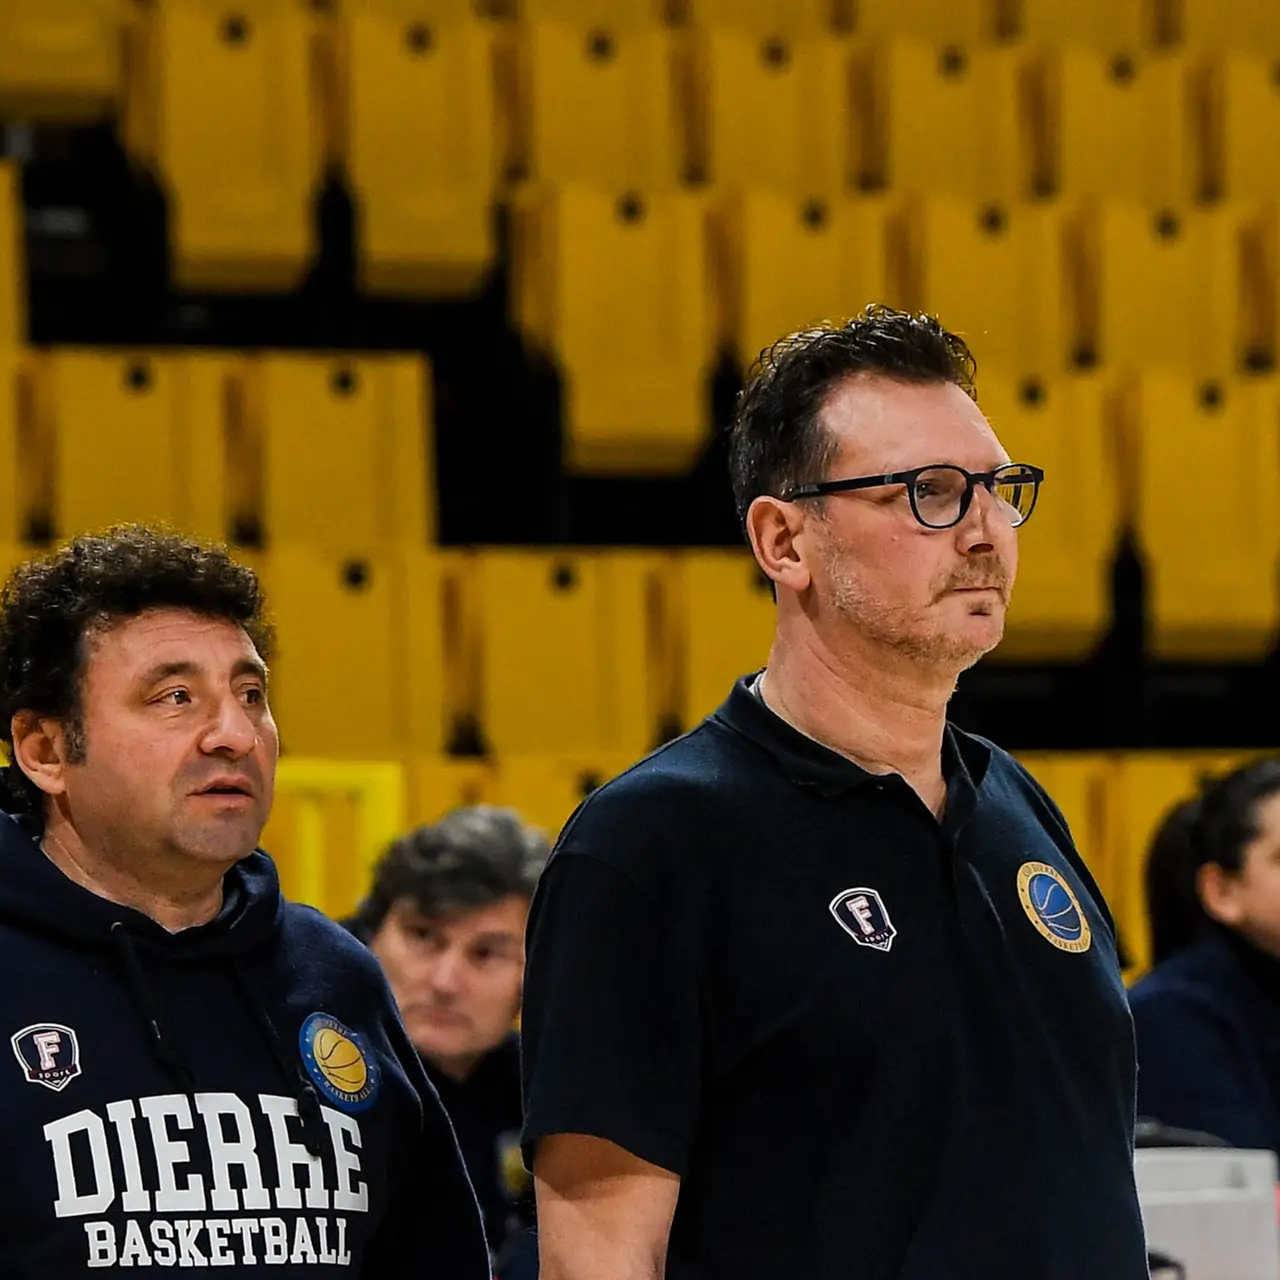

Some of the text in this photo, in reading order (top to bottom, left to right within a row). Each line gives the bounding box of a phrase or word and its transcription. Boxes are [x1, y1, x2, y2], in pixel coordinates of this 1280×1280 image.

[845, 895, 875, 935] F
[32, 1031, 61, 1071] F
[43, 1092, 369, 1218] DIERRE
[84, 1216, 351, 1268] BASKETBALL
